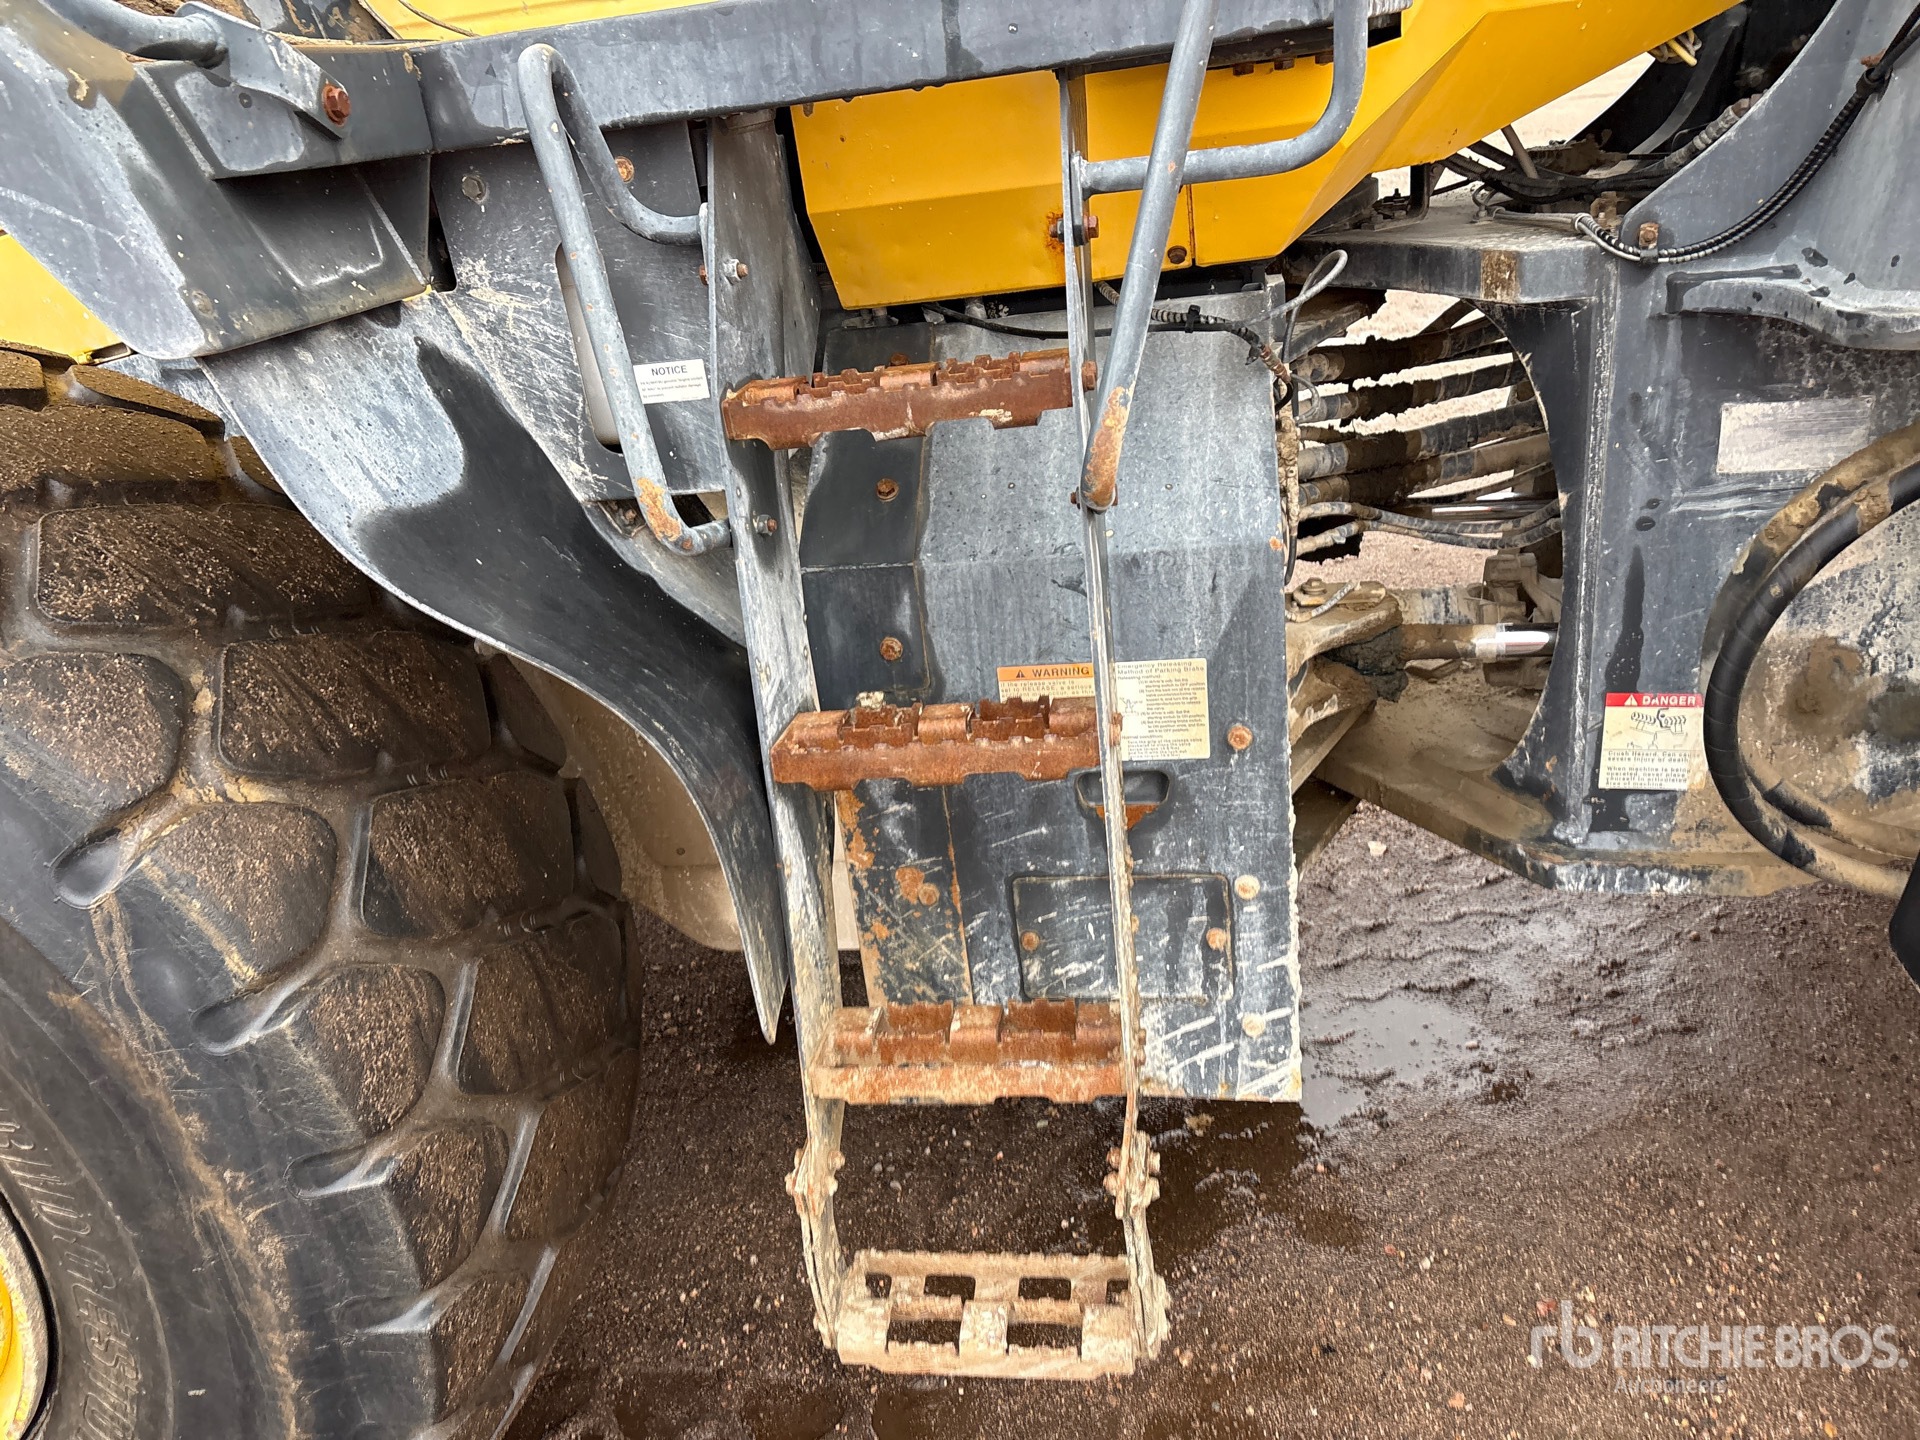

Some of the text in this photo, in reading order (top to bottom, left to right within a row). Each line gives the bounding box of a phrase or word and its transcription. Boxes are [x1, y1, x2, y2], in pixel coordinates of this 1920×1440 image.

[651, 365, 688, 376] NOTICE
[1032, 667, 1090, 677] WARNING
[1642, 695, 1696, 705] DANGER
